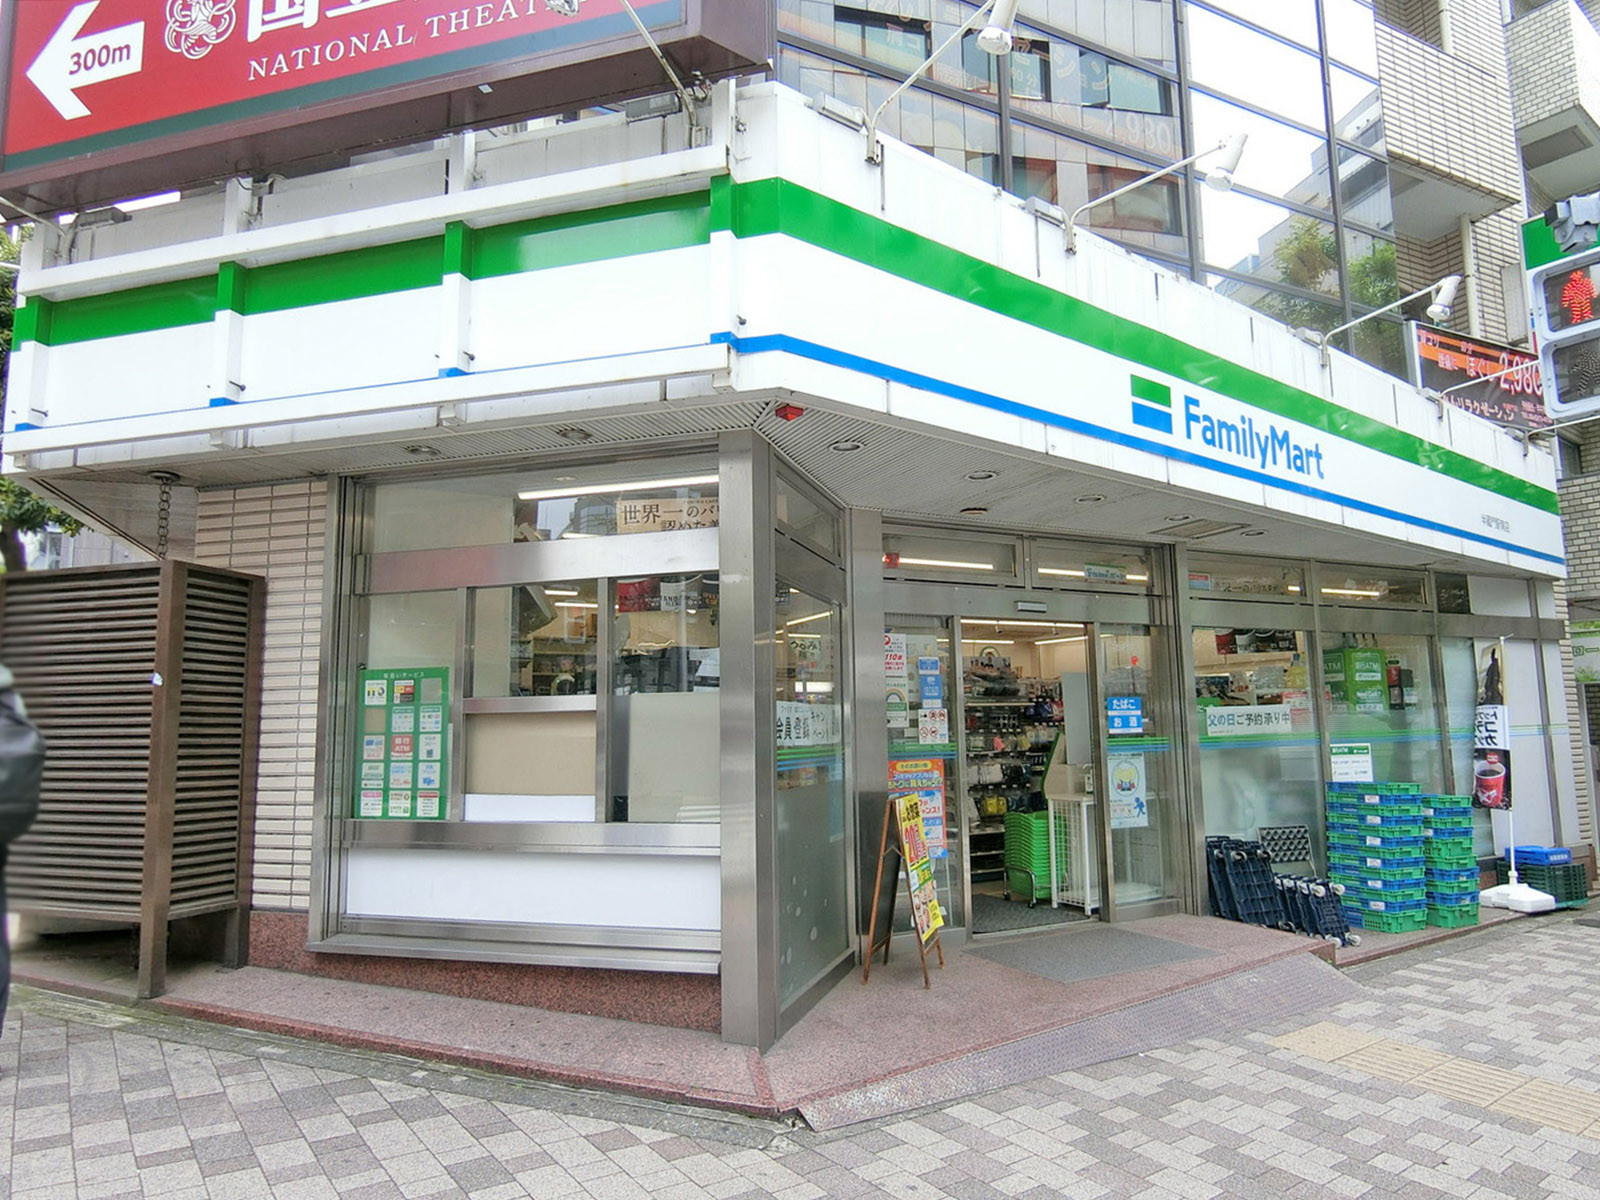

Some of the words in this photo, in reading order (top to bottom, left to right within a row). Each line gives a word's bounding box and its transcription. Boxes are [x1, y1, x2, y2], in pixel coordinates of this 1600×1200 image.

[248, 25, 413, 81] NATIONAL
[425, 0, 551, 38] THEAT
[69, 44, 131, 76] 300m
[1184, 395, 1324, 479] FamilyMart
[621, 503, 719, 525] 世界一のバ
[1112, 699, 1136, 710] たばこ
[1208, 712, 1290, 727] 父の日ご予約承り中
